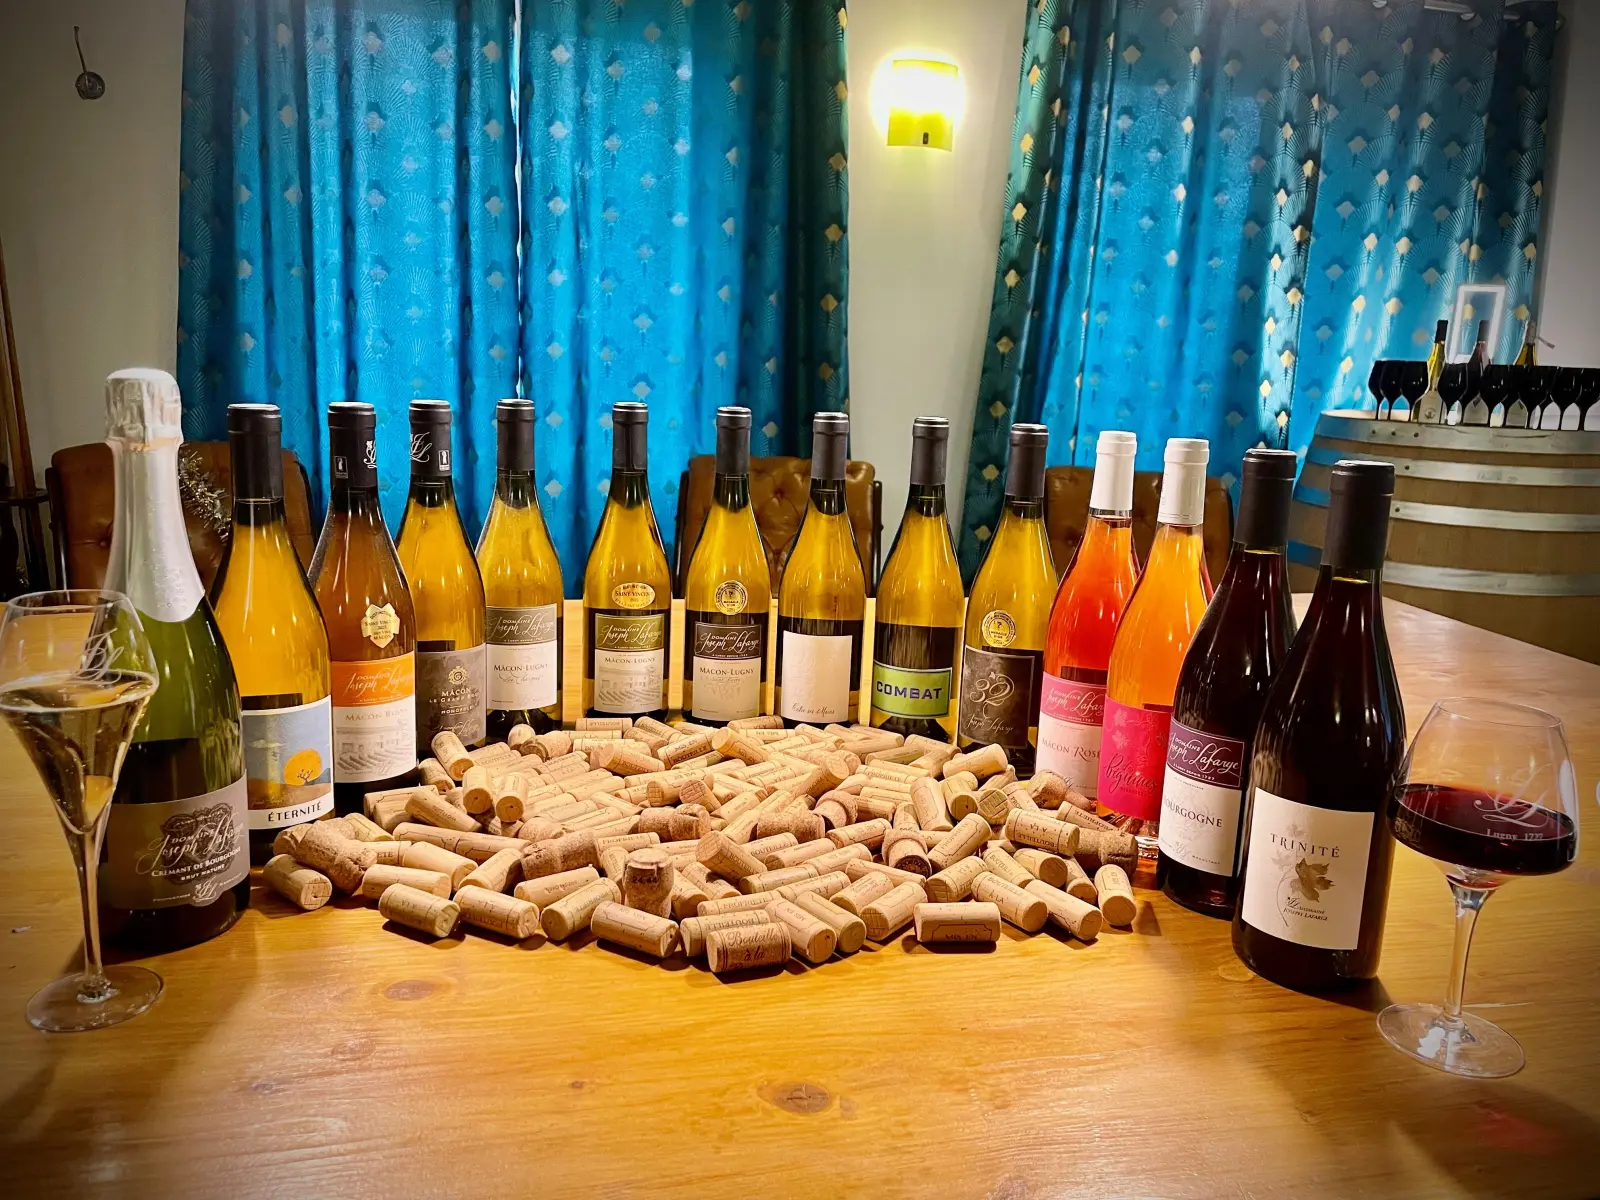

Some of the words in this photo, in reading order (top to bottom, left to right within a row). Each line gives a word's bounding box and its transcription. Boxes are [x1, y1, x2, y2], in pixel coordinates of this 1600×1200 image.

[876, 680, 943, 700] COMBAT
[1069, 691, 1105, 718] Lafar
[1189, 742, 1240, 774] Lafarge
[267, 801, 322, 822] ÉTERNITÉ
[1270, 832, 1341, 859] TRINITÉ
